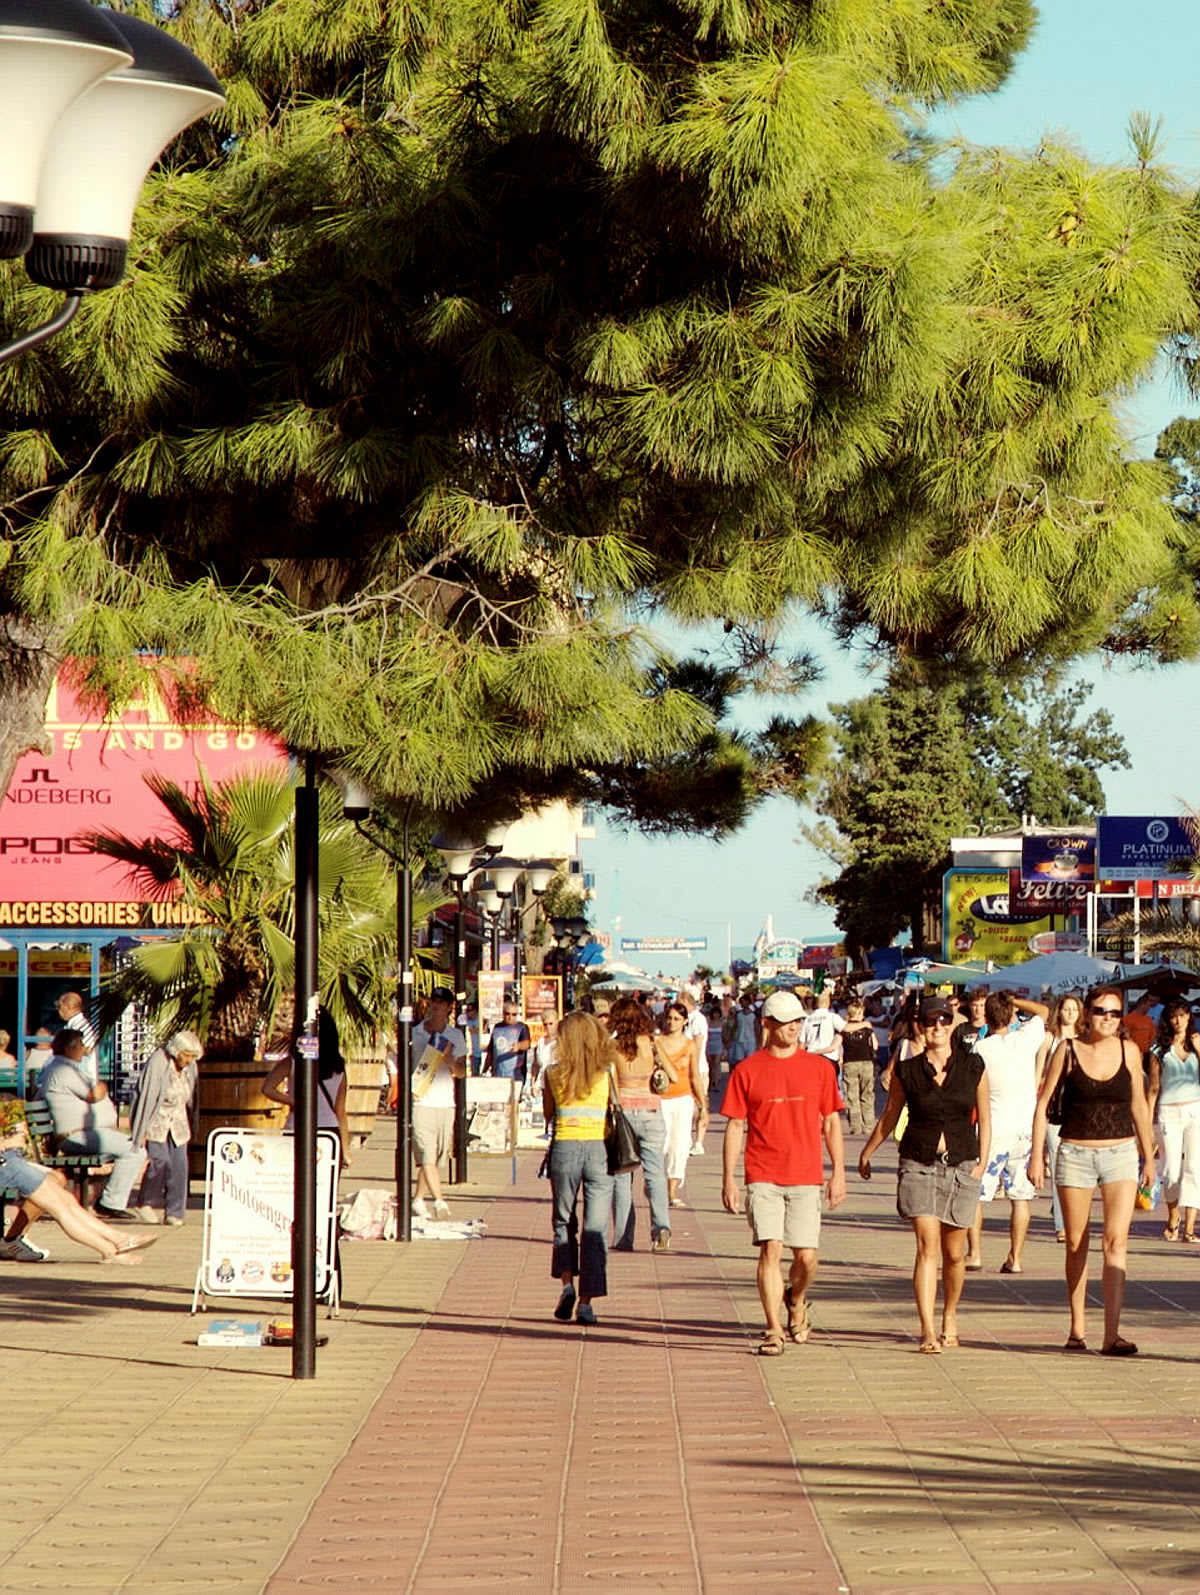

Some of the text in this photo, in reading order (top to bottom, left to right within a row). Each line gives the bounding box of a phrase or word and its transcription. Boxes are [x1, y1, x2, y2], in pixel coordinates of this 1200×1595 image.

[107, 732, 184, 750] AND
[206, 732, 256, 750] GO
[1046, 838, 1088, 850] CROWN
[1122, 843, 1191, 854] PLATINUM
[0, 902, 140, 924] ACCESSORIES
[812, 1023, 821, 1041] 7
